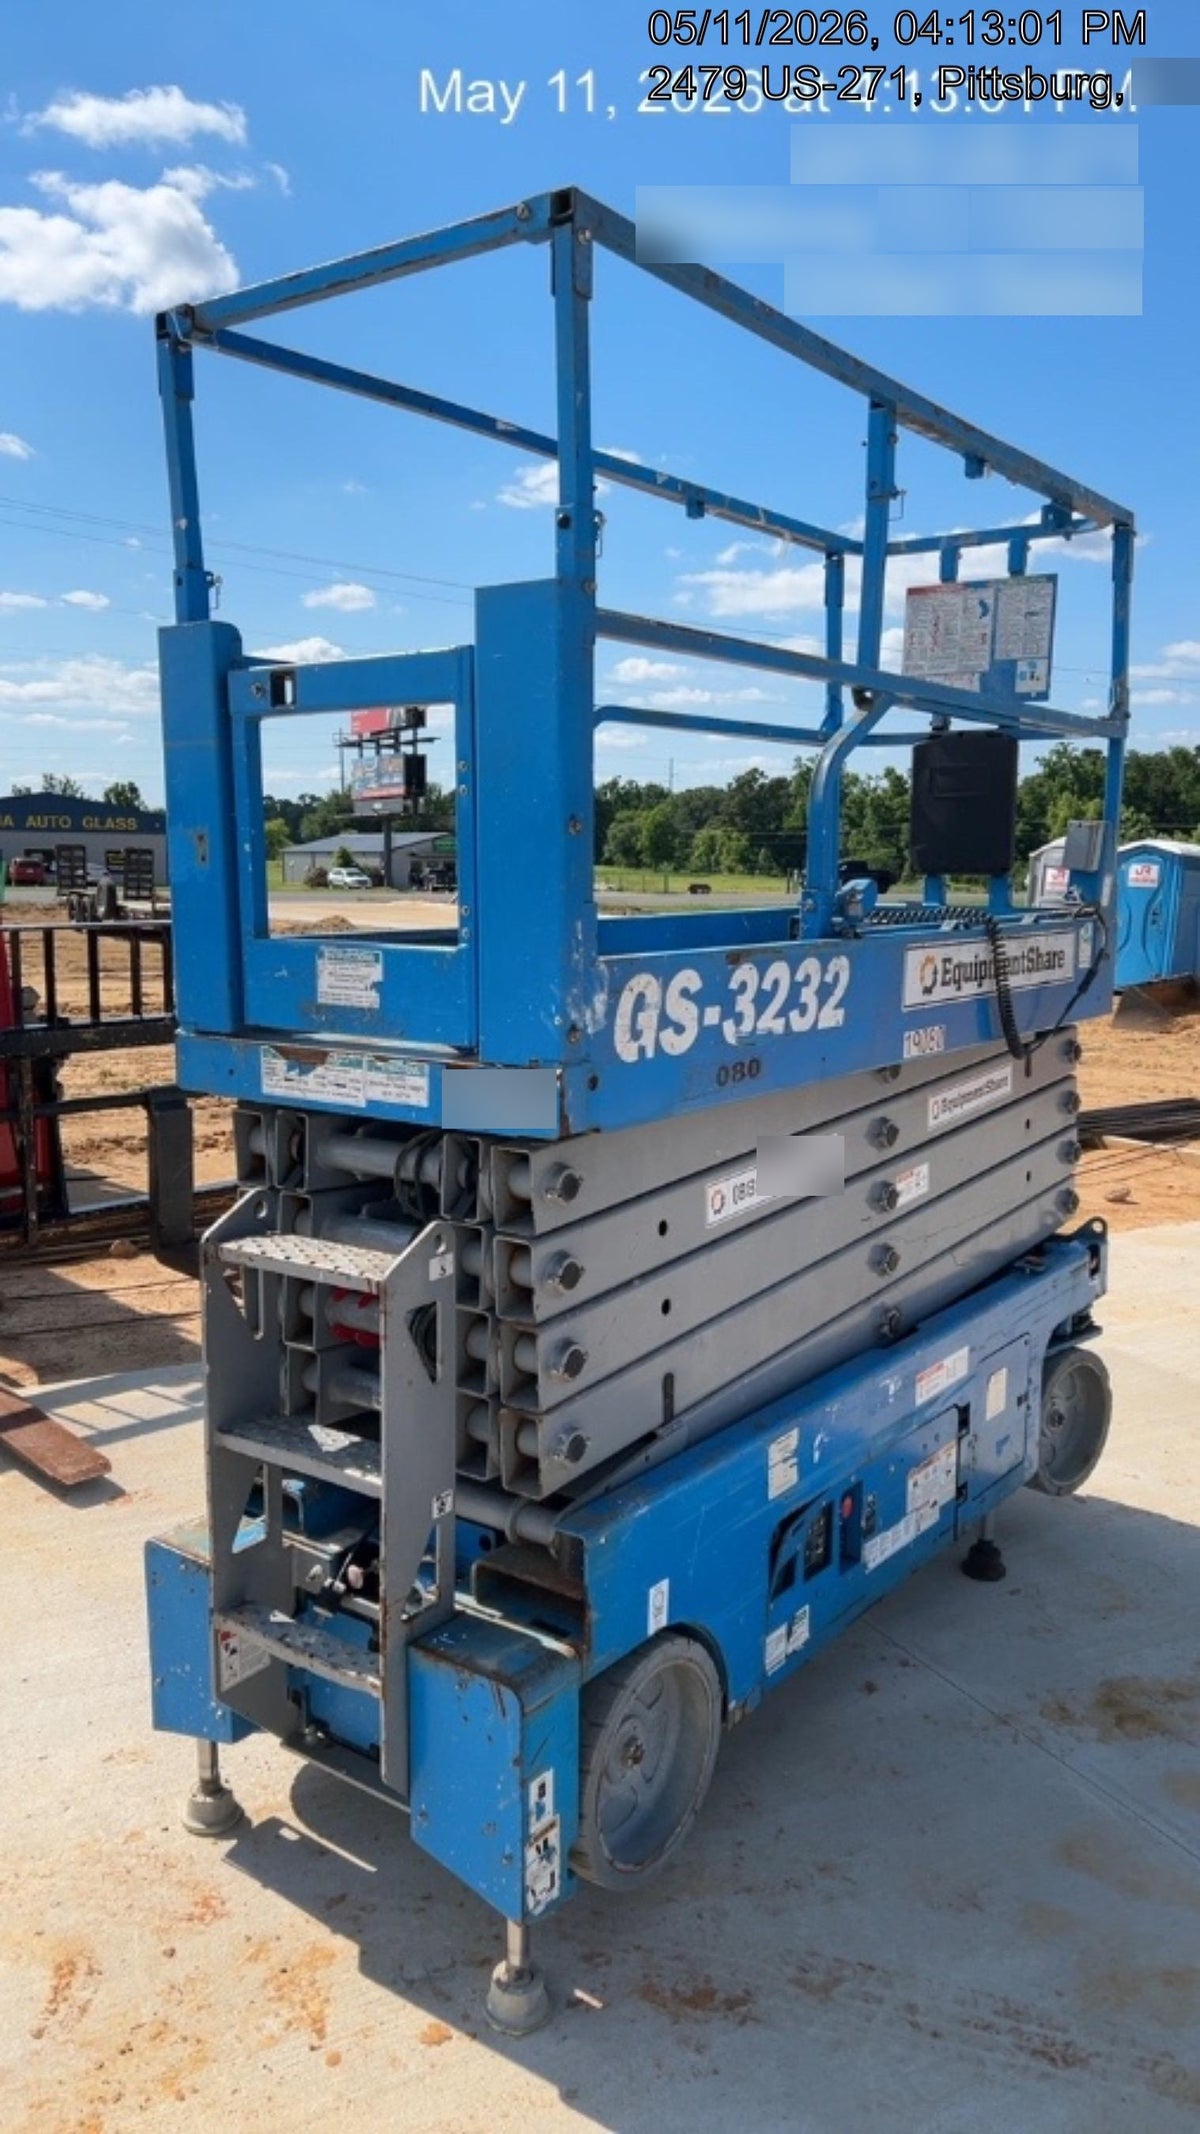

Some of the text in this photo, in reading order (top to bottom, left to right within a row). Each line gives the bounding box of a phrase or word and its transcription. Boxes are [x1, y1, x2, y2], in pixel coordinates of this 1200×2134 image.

[26, 815, 71, 828] AUTO
[82, 816, 137, 830] GLASS
[614, 955, 850, 1063] GS-3232
